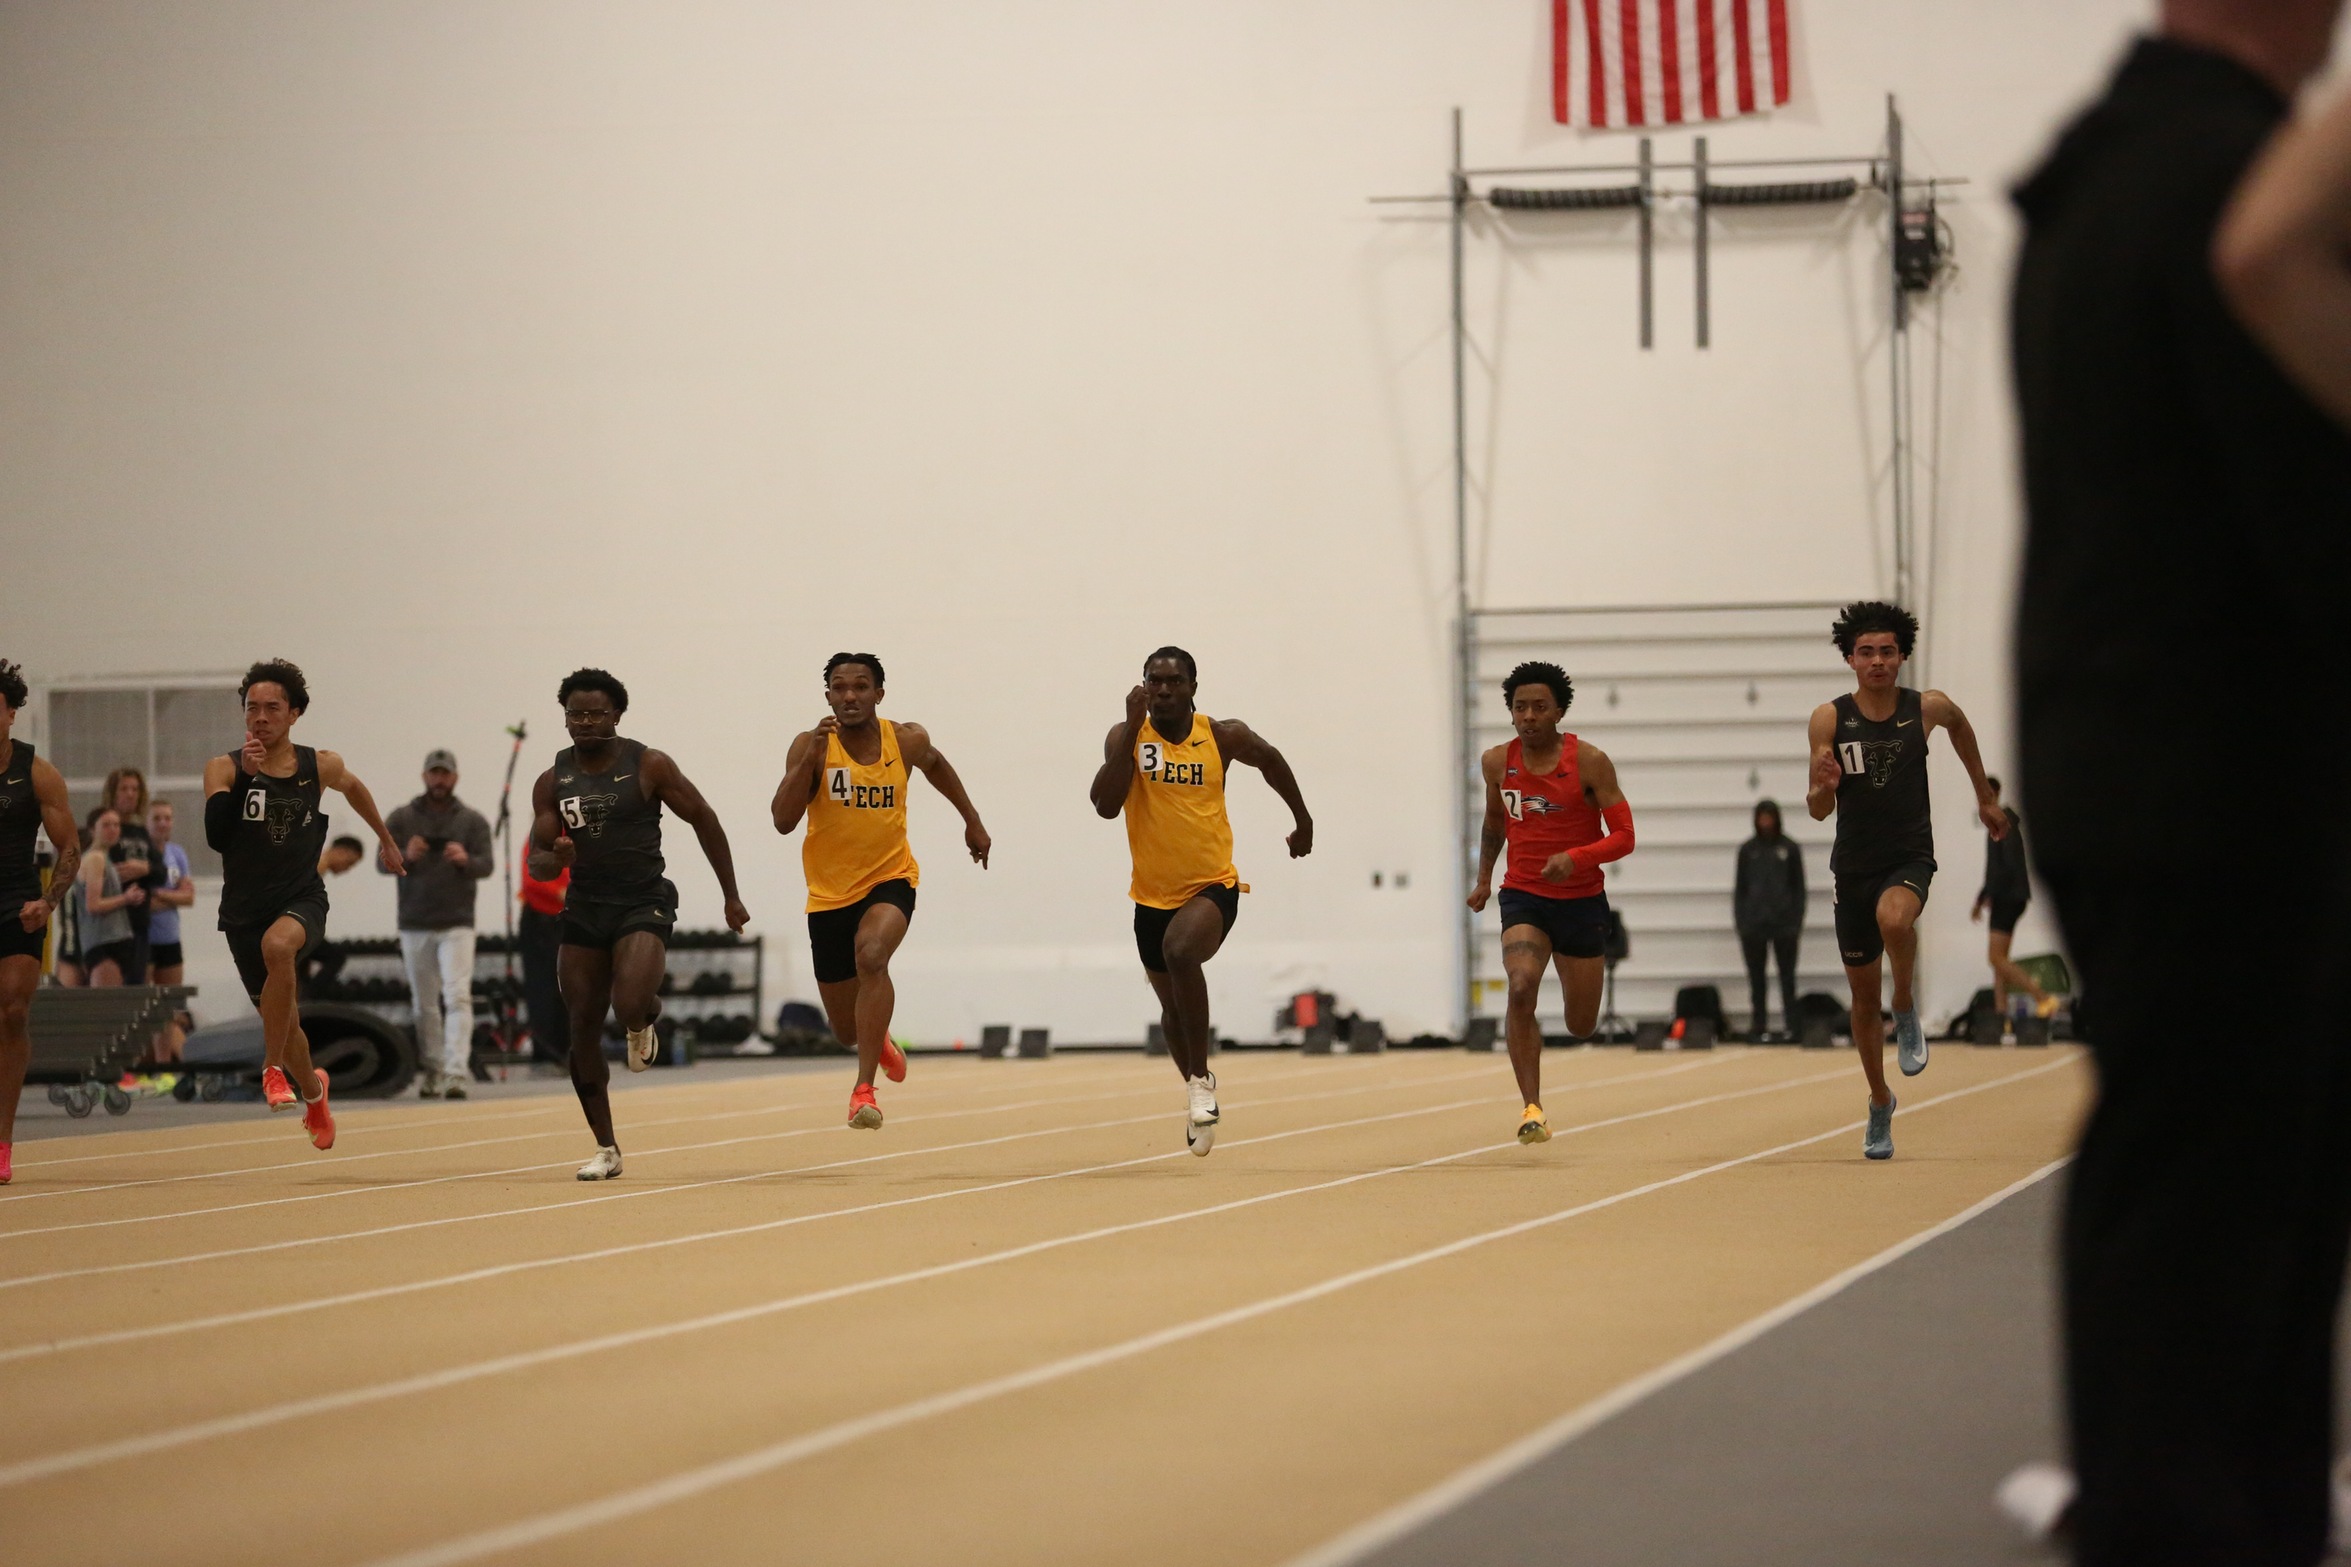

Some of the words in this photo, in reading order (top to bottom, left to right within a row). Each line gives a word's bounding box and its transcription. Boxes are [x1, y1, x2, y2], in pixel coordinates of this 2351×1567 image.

[1143, 744, 1158, 771] 3
[1844, 744, 1858, 773] 1
[831, 769, 848, 799] 4
[245, 790, 260, 819] 6
[563, 799, 579, 827] 5
[1504, 791, 1520, 818] 2
